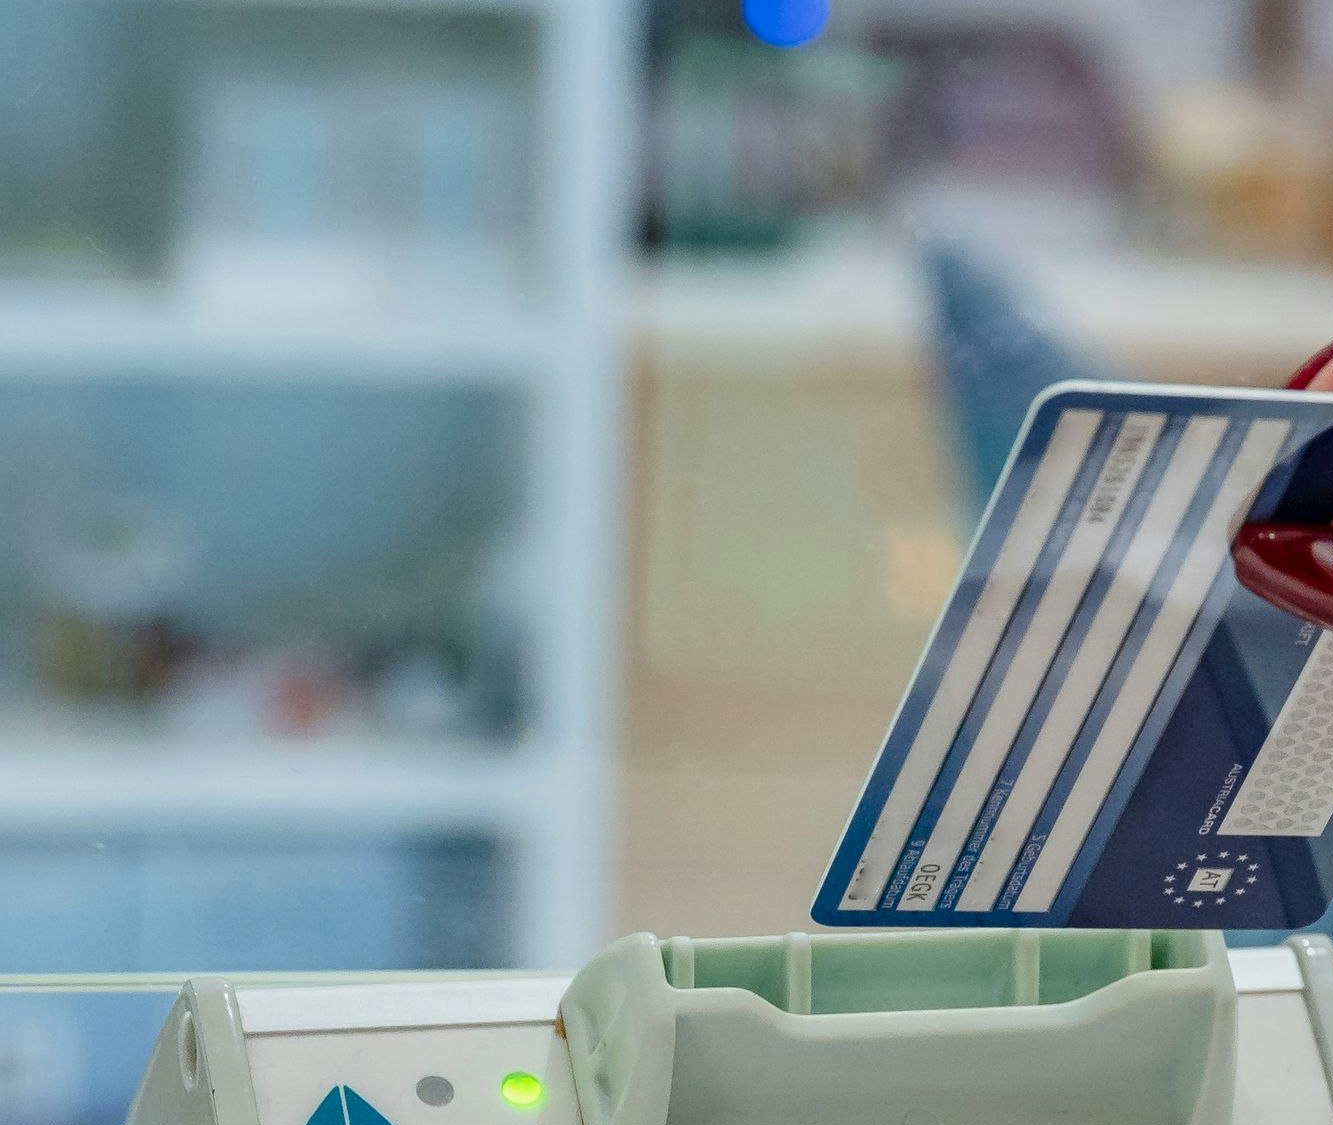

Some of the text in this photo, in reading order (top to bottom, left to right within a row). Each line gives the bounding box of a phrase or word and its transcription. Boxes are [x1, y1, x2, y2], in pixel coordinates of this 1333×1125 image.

[1199, 763, 1243, 835] AUSTRIACARD
[882, 849, 921, 908] Ablaufdatum
[906, 863, 941, 901] OEGK
[1000, 843, 1041, 909] Geburtsdatum
[1200, 870, 1221, 889] AT
